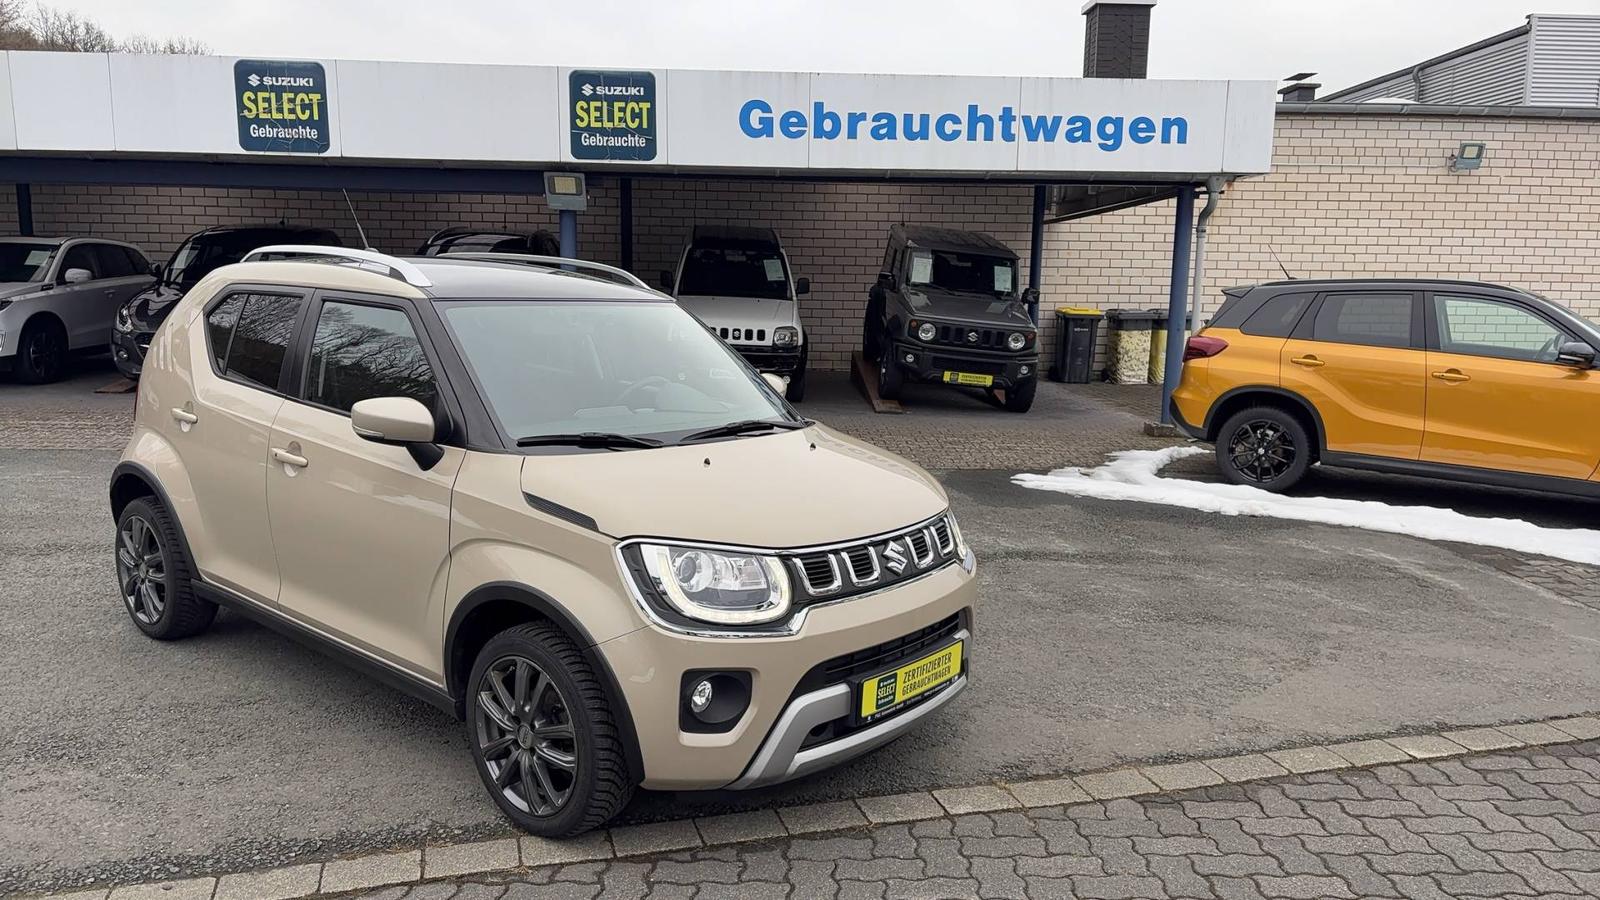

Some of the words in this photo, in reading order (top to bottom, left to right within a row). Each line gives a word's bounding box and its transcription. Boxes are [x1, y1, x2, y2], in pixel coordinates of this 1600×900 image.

[263, 76, 314, 86] SUZUKI
[596, 86, 644, 96] SUZUKI
[242, 91, 321, 121] SELECT
[575, 100, 651, 129] SELECT
[250, 124, 318, 139] Gebrauchte
[738, 99, 1188, 152] Gebrauchtwagen
[581, 132, 646, 147] Gebrauchte
[903, 652, 952, 684] ZERTIFIZIERTER
[877, 683, 896, 699] SELECT
[901, 665, 951, 696] GEBRAUCHTWAGEN
